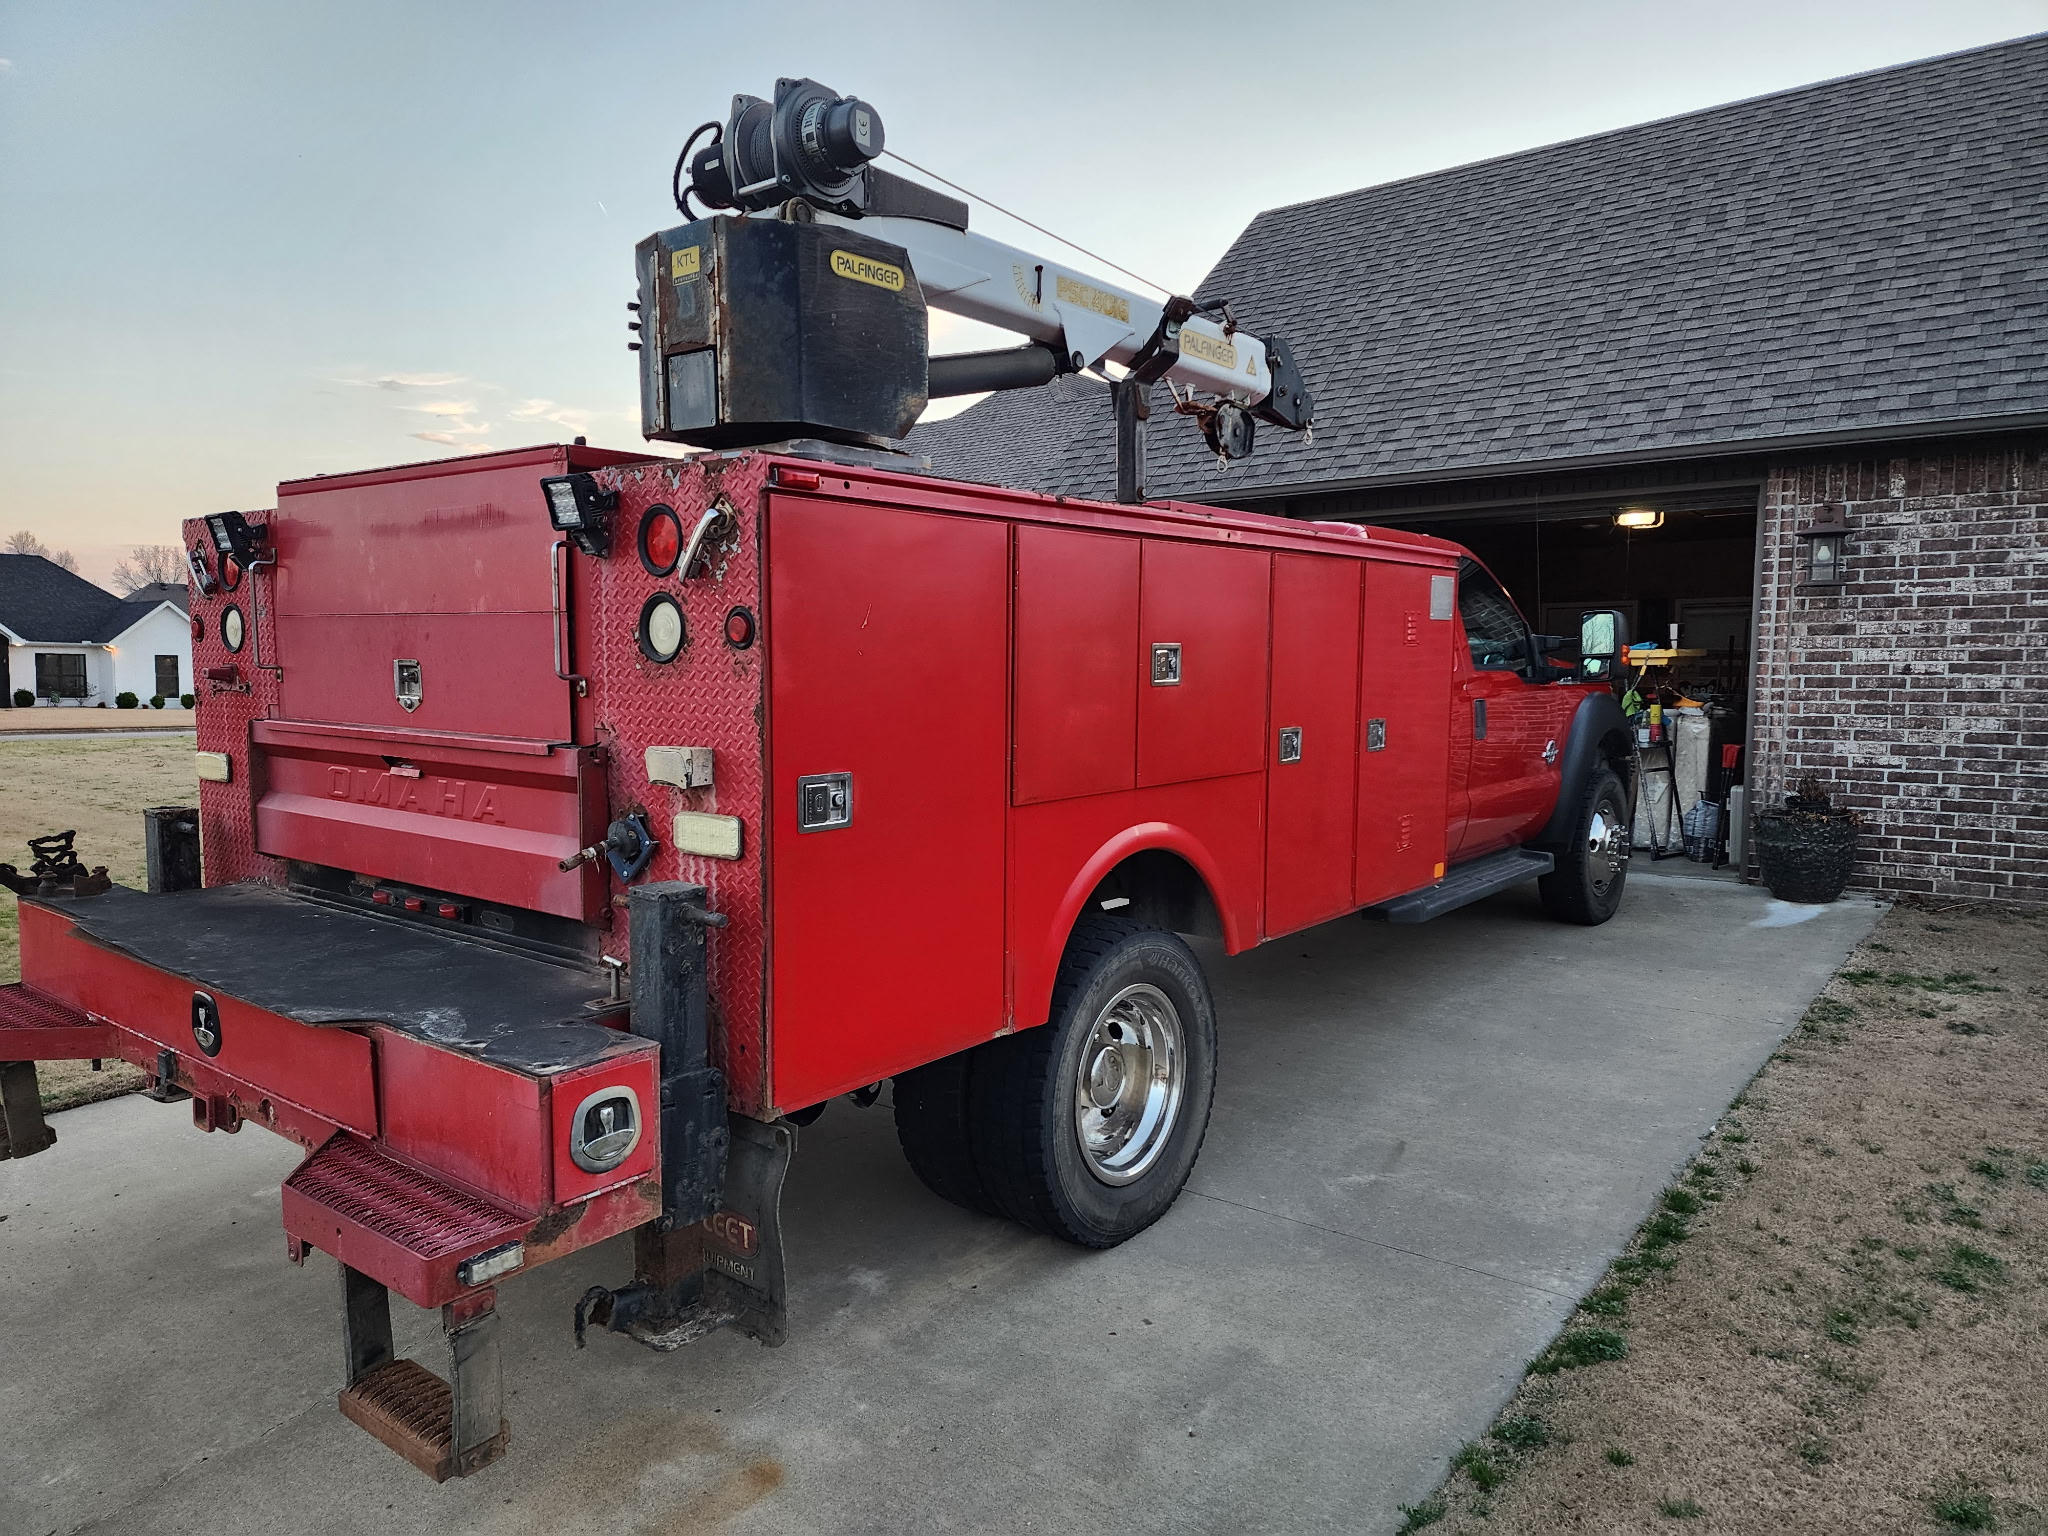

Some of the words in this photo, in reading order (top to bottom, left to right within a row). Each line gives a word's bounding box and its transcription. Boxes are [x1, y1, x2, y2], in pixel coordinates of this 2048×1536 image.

[836, 255, 899, 287] PALFINGER
[1184, 333, 1235, 365] PALFINGER
[327, 765, 506, 824] OMAHA
